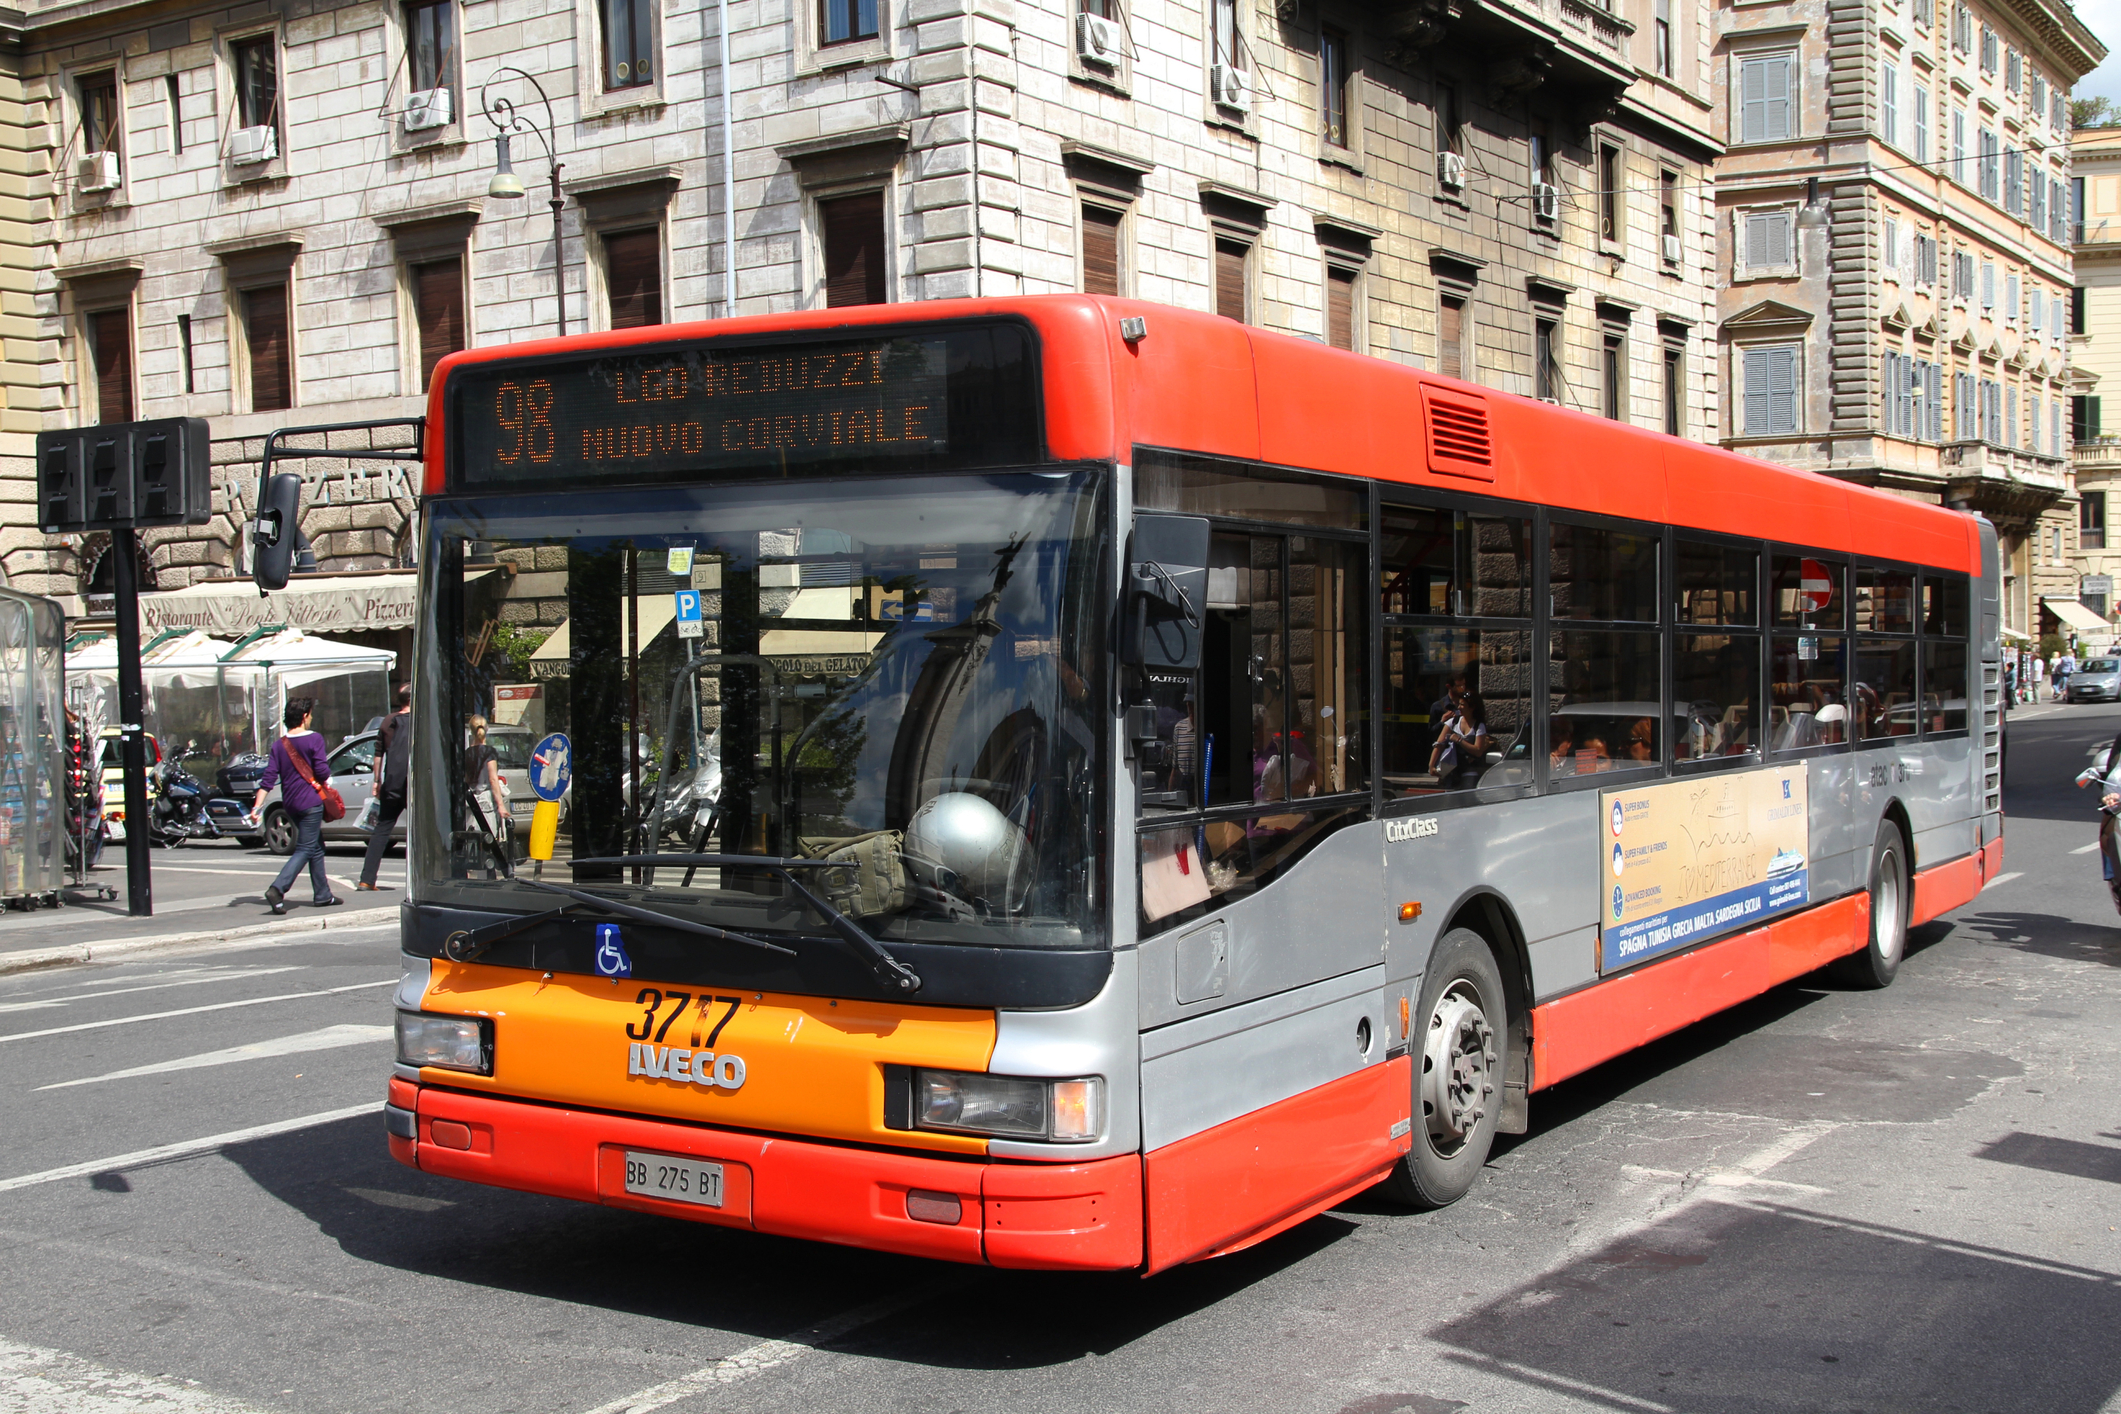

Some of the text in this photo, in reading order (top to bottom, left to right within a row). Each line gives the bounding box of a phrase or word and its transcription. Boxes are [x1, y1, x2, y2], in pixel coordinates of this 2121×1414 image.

[616, 350, 883, 404] LGO REDUZZI
[496, 379, 555, 464] 98
[582, 406, 929, 460] NUOVO CORVIALE
[145, 608, 214, 627] Ristorante
[364, 595, 416, 620] Pizzeri
[680, 594, 695, 618] P
[804, 661, 824, 673] DEL
[825, 657, 867, 672] GELATO
[1871, 762, 1888, 787] atac
[1386, 818, 1438, 843] CityClass
[1619, 896, 1761, 957] SPAGNA TUNISIA GRECIA MALTA SARDEGNA SICILIA
[1619, 920, 1645, 937] collegamenti
[626, 988, 742, 1048] 3717
[629, 1042, 747, 1090] IVECO
[626, 1160, 721, 1198] BB 275 BT
